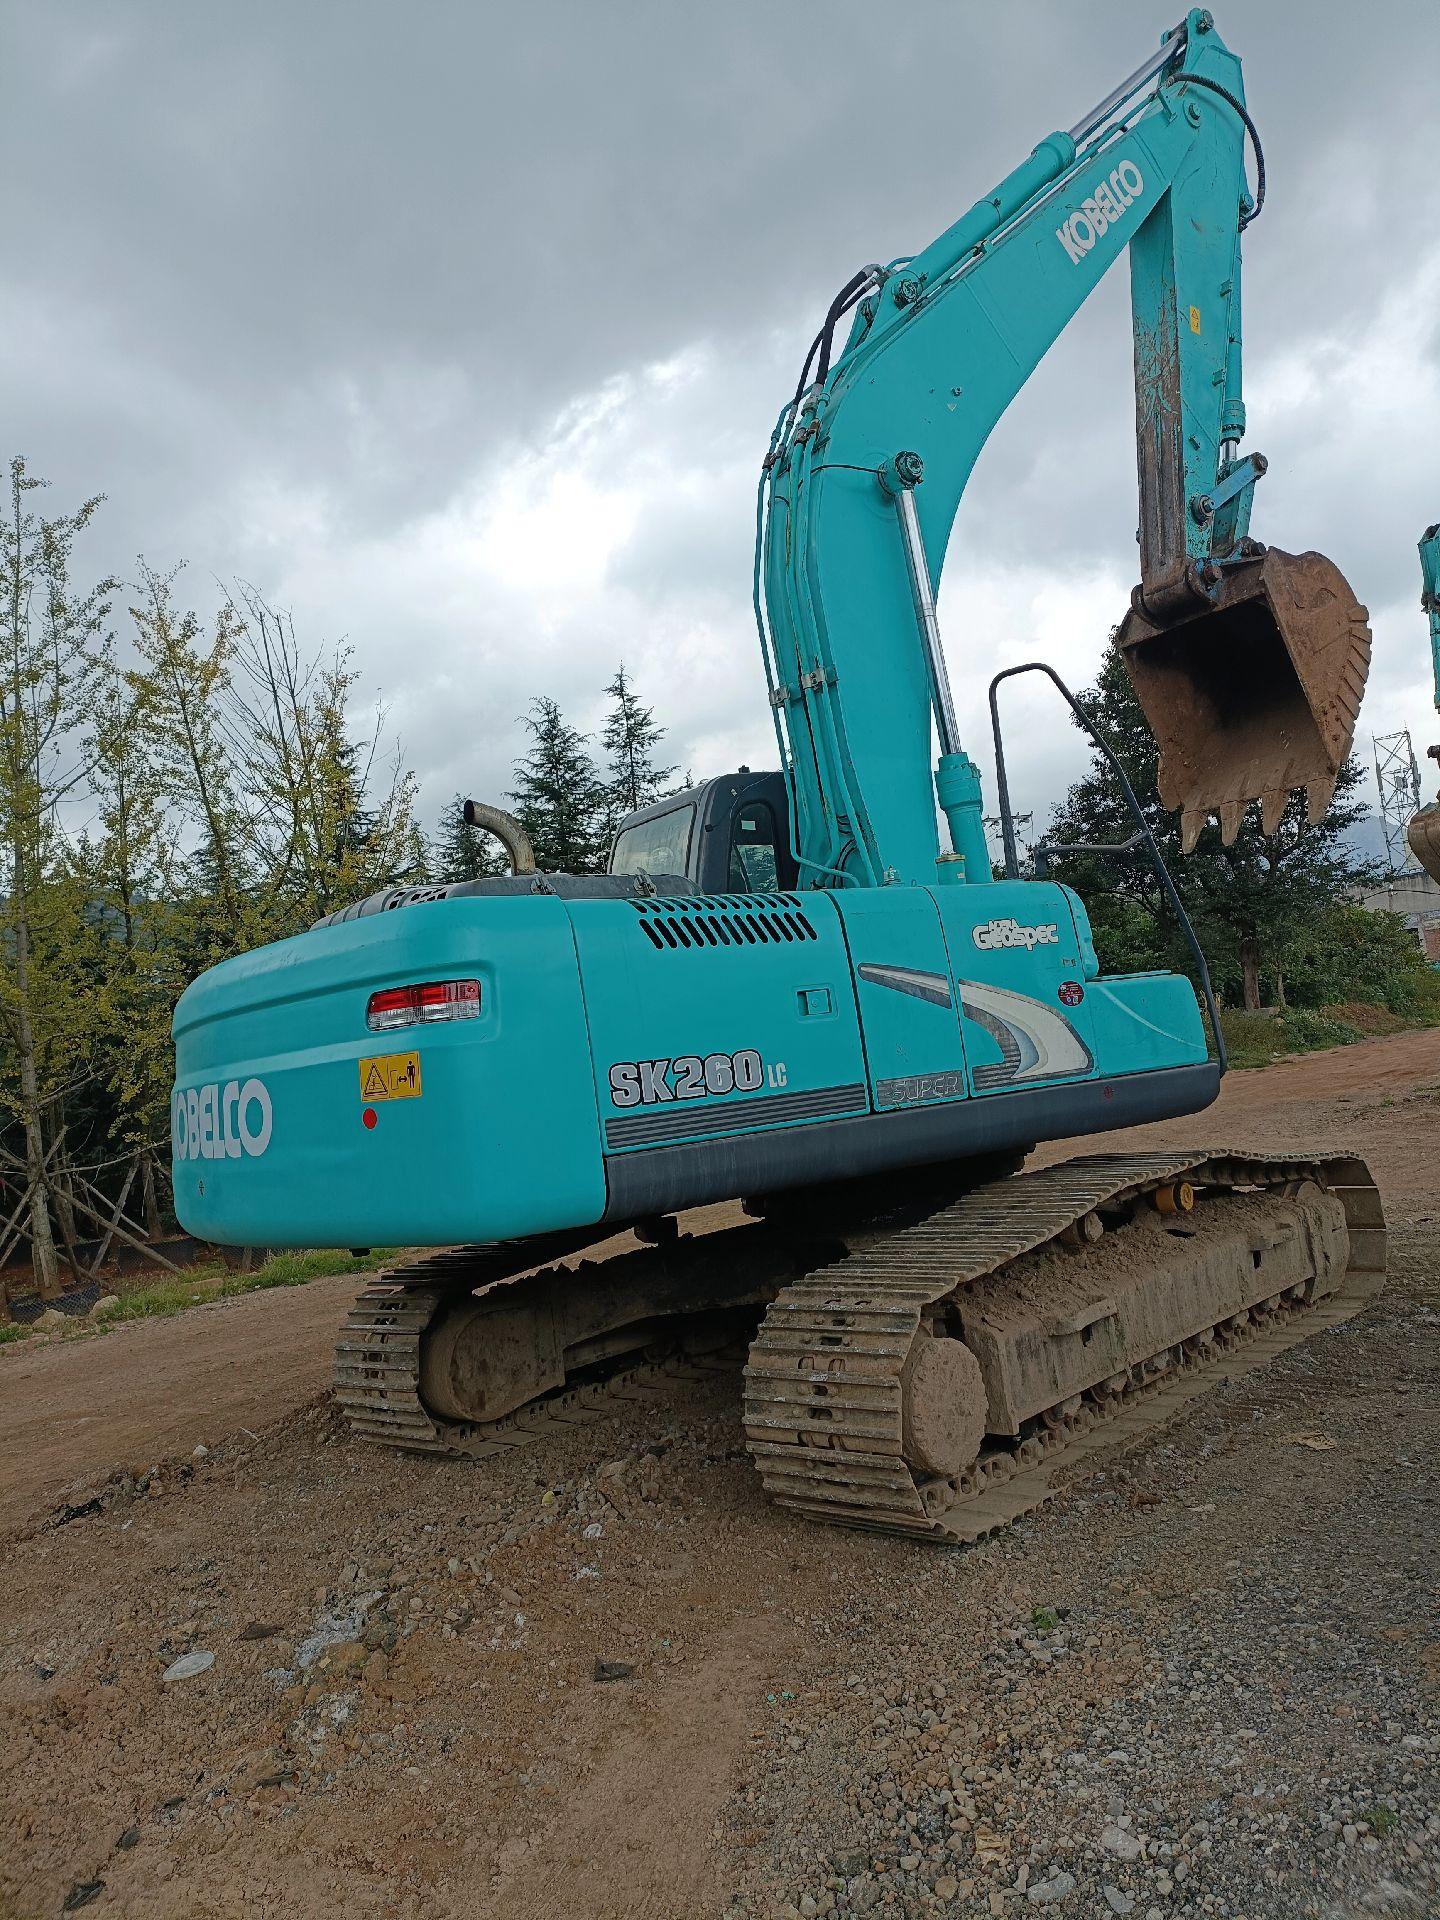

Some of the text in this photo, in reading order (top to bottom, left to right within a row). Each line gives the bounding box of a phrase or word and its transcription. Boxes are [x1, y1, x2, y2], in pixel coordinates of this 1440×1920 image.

[1056, 159, 1144, 265] KOBELCO
[608, 1049, 788, 1108] SK260 LC
[891, 1074, 959, 1102] SUPER
[171, 1078, 273, 1161] OBELCO
